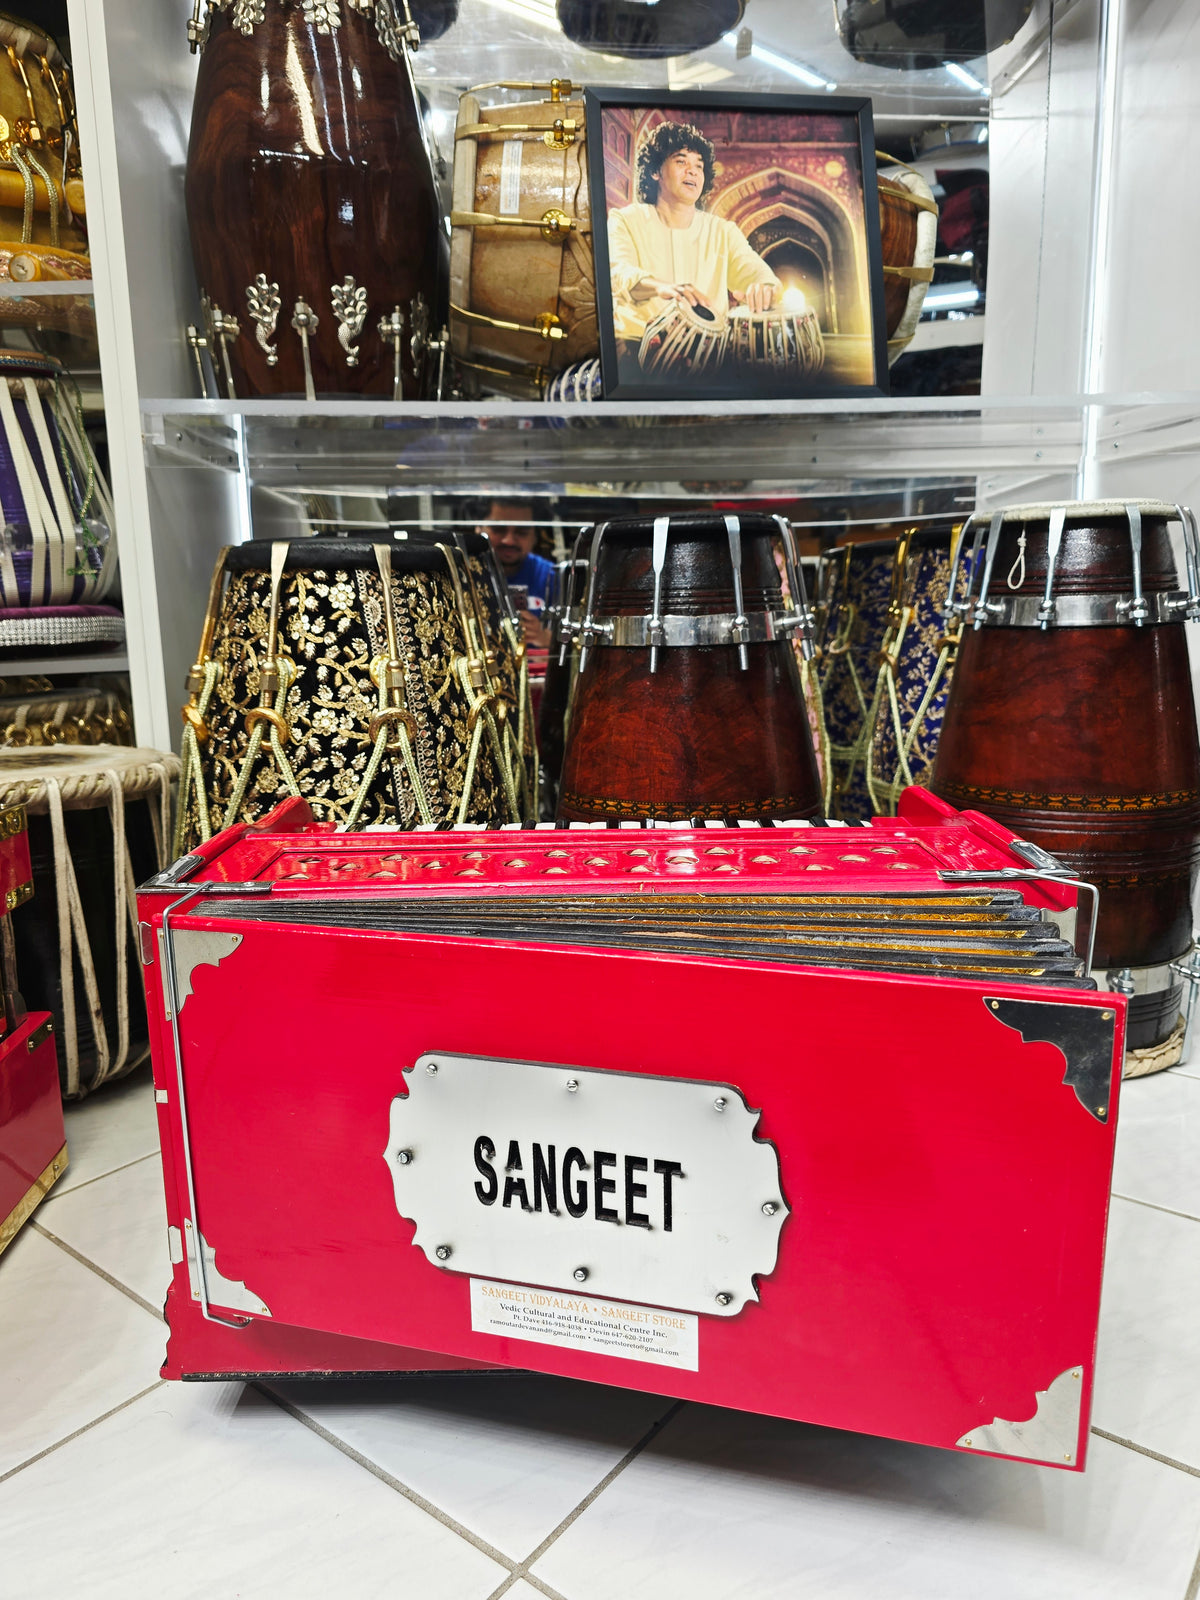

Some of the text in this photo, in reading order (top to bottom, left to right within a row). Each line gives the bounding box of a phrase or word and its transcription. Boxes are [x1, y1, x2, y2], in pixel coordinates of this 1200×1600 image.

[473, 1135, 682, 1232] SANGEET
[481, 1285, 686, 1329] SANGEET VIDYALAYA SANGEET STORE
[499, 1303, 668, 1339] Vedic Cultural and Educational Centre Inc.
[523, 1316, 540, 1324] Dave
[589, 1327, 610, 1336] Devin
[611, 1331, 654, 1344] 647-620-2107
